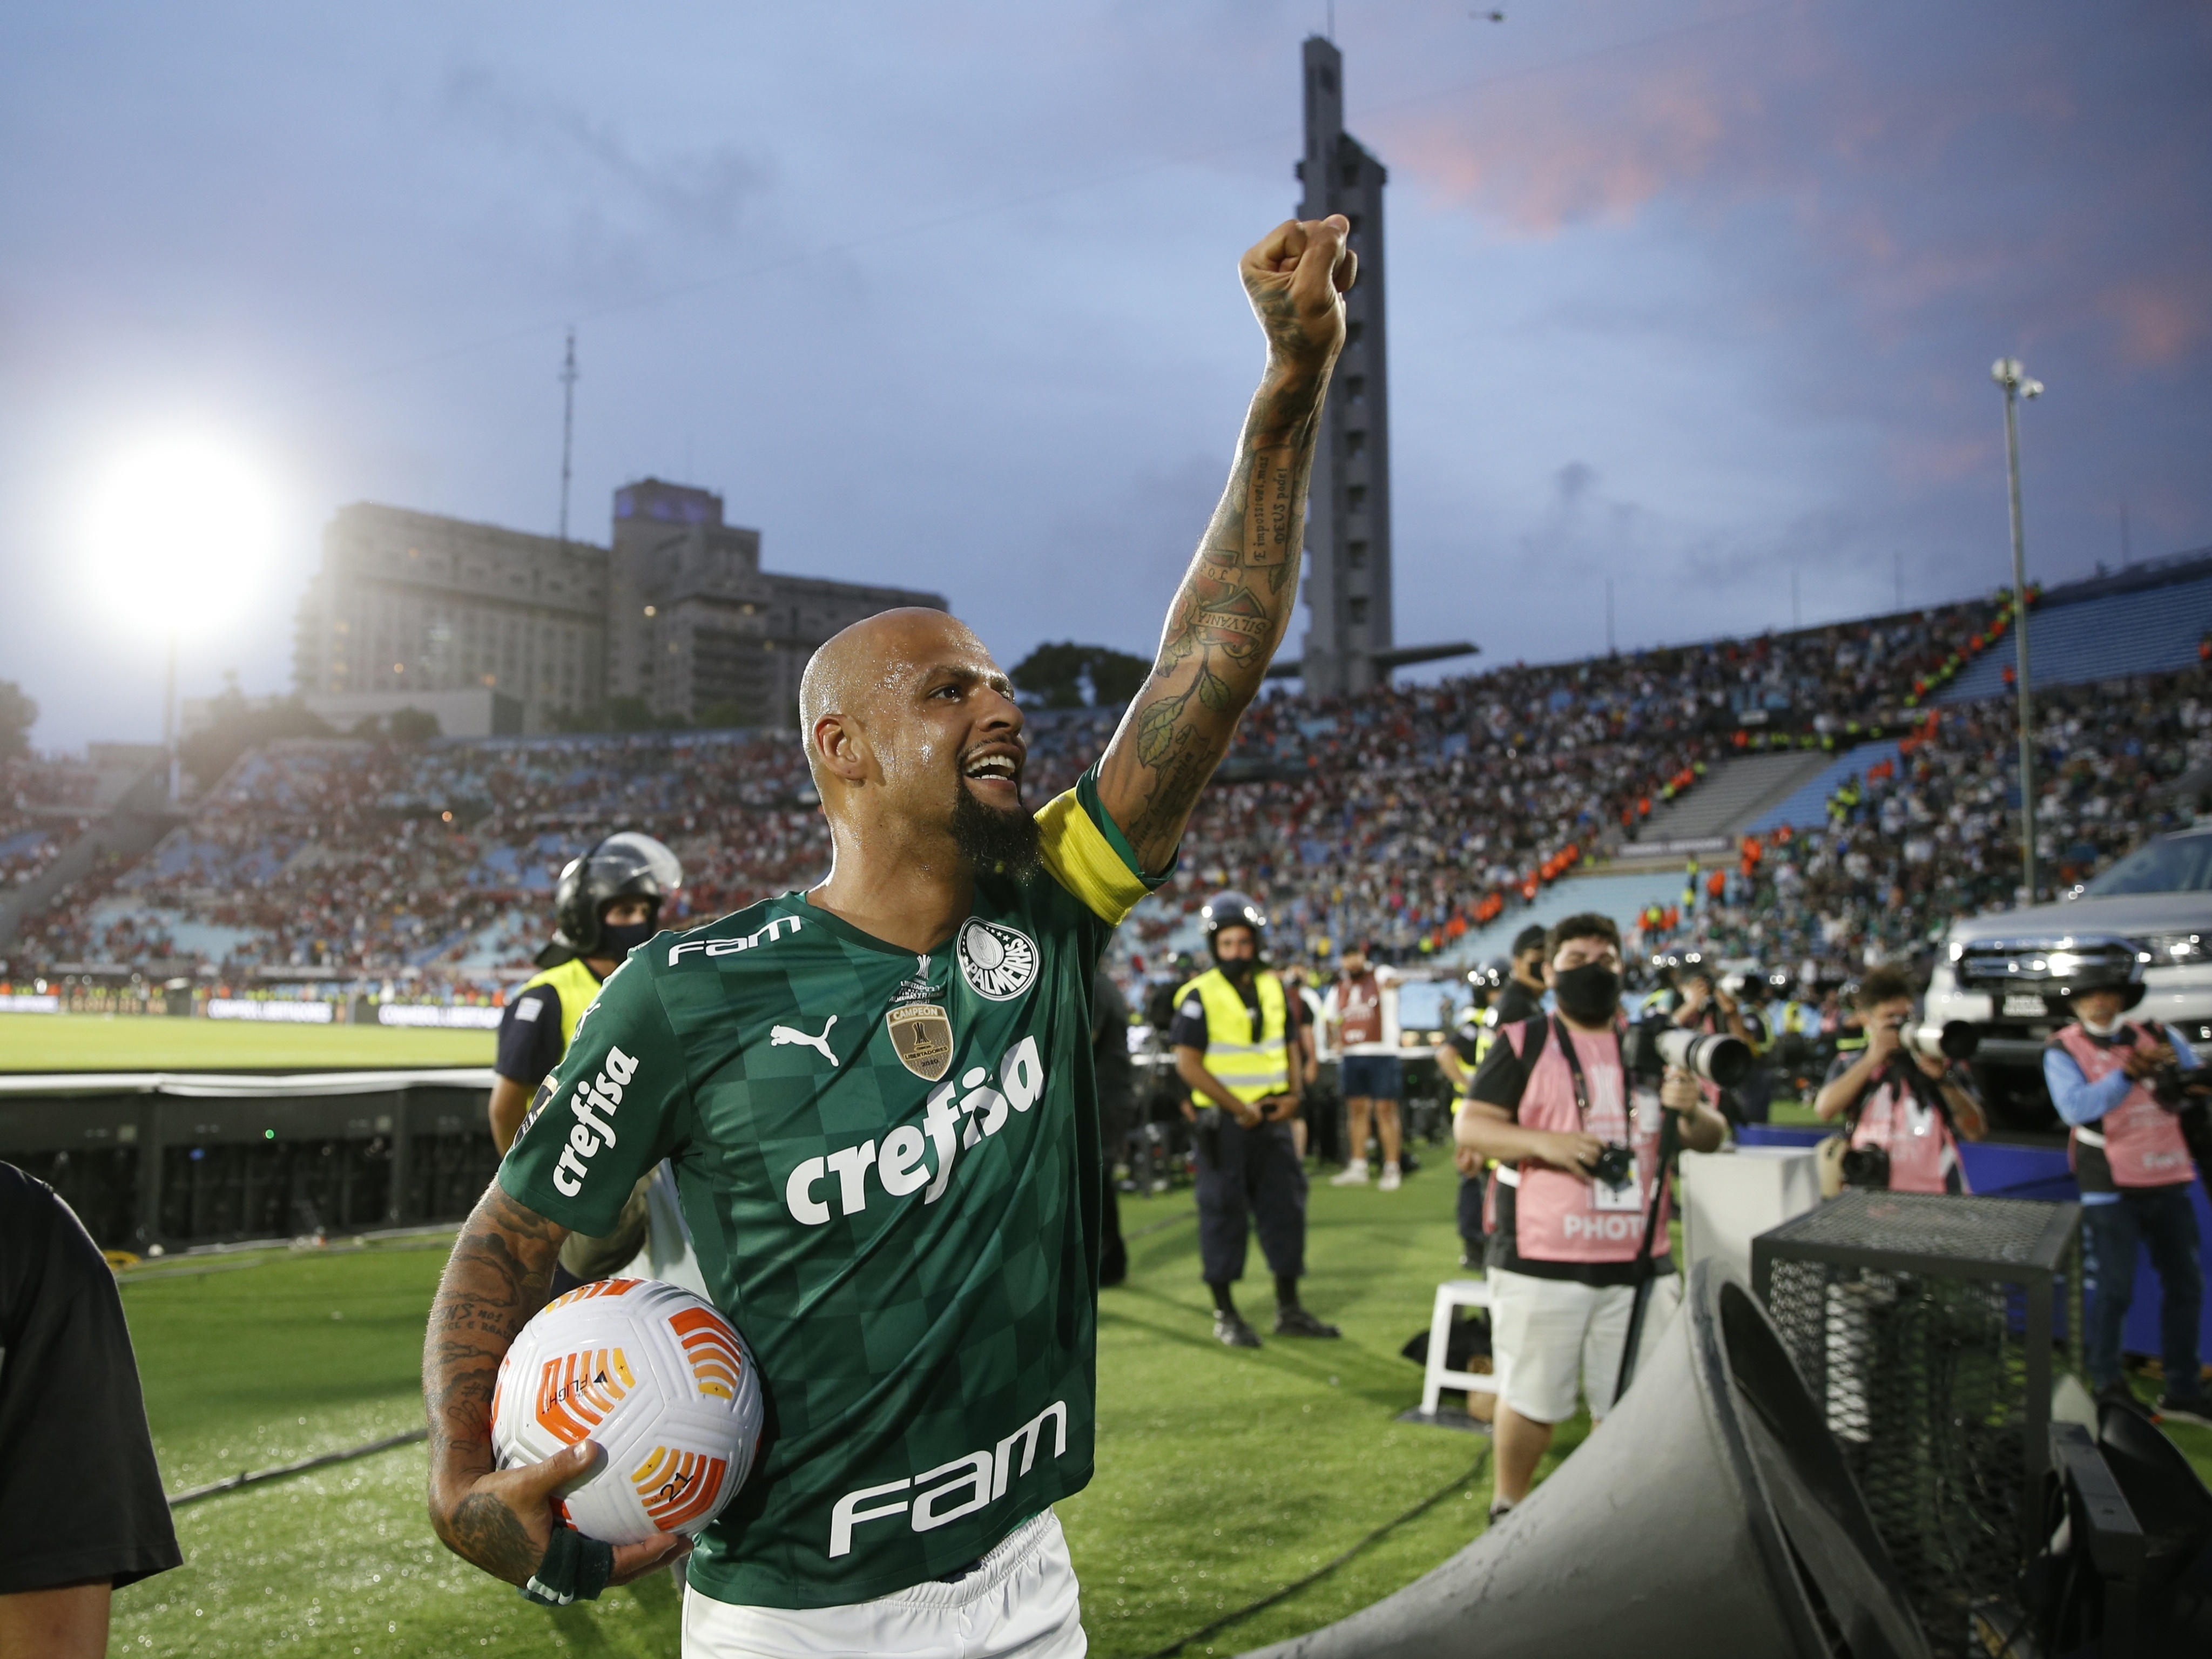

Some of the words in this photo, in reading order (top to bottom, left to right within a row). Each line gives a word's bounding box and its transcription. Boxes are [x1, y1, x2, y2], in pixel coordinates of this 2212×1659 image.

[1273, 503, 1285, 544] DEUS
[1198, 611, 1267, 635] SILVANIA
[966, 938, 1032, 995] PALMEIRAS
[893, 1006, 938, 1020] CAMPEÓN
[905, 1046, 948, 1060] LIBERTADORES
[553, 1045, 639, 1197] crefisa
[786, 1035, 1044, 1225] crefisa
[1563, 1213, 1647, 1240] PHOT
[660, 1472, 694, 1502] 21
